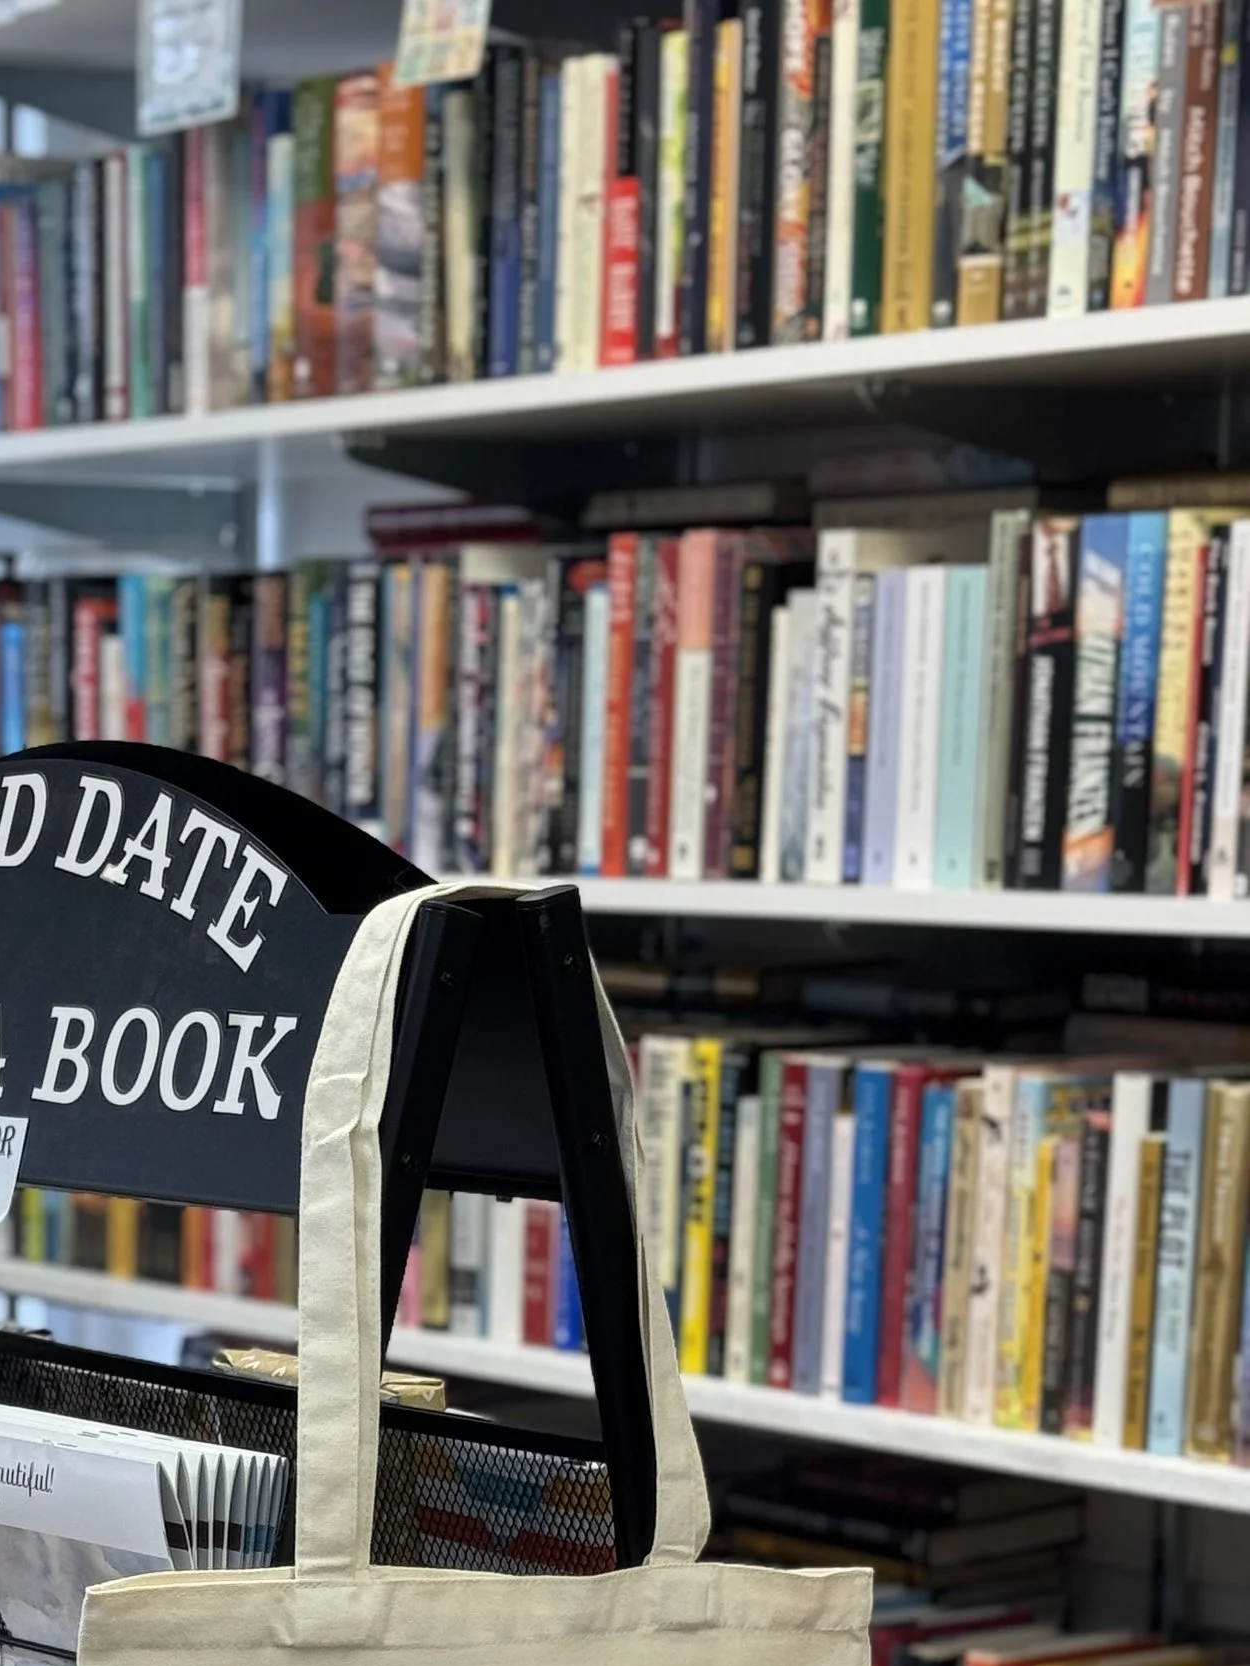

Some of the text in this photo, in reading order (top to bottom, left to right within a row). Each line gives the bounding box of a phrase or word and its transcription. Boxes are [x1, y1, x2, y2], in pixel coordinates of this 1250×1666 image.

[1067, 722, 1115, 837] FRANZEN
[55, 775, 288, 973] DATE
[32, 1007, 297, 1120] BOOK
[1158, 1149, 1193, 1271] THE PLOT
